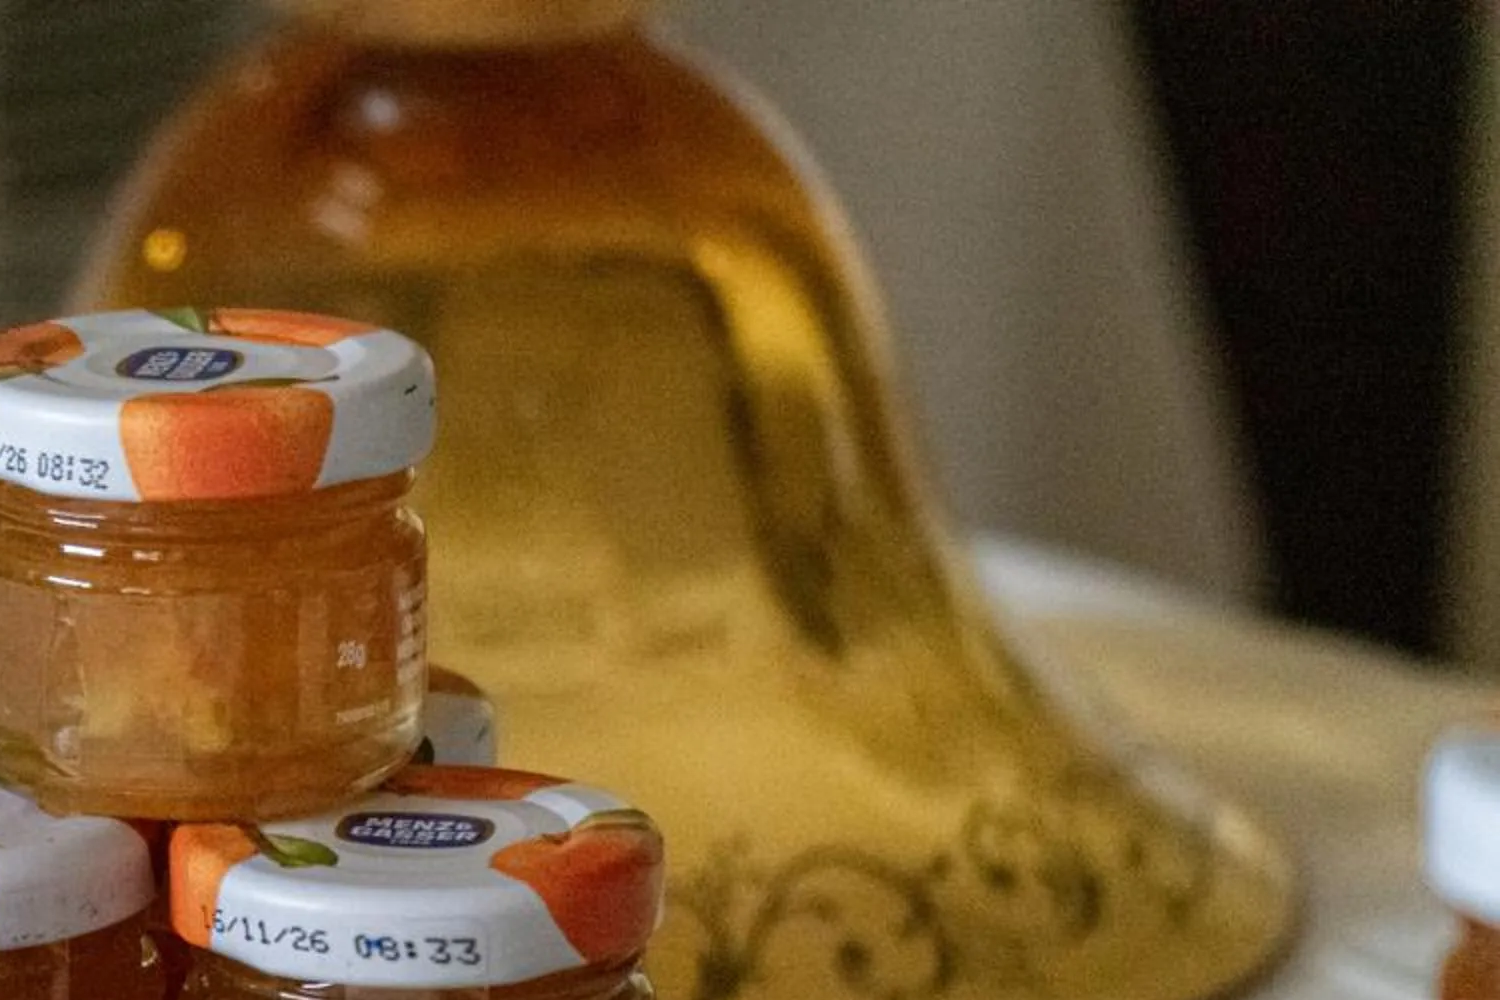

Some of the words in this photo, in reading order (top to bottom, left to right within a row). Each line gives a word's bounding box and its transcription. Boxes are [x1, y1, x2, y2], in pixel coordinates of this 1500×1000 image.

[38, 452, 110, 490] 08:32
[201, 905, 330, 954] 16/11/26
[354, 934, 481, 966] 08:33
